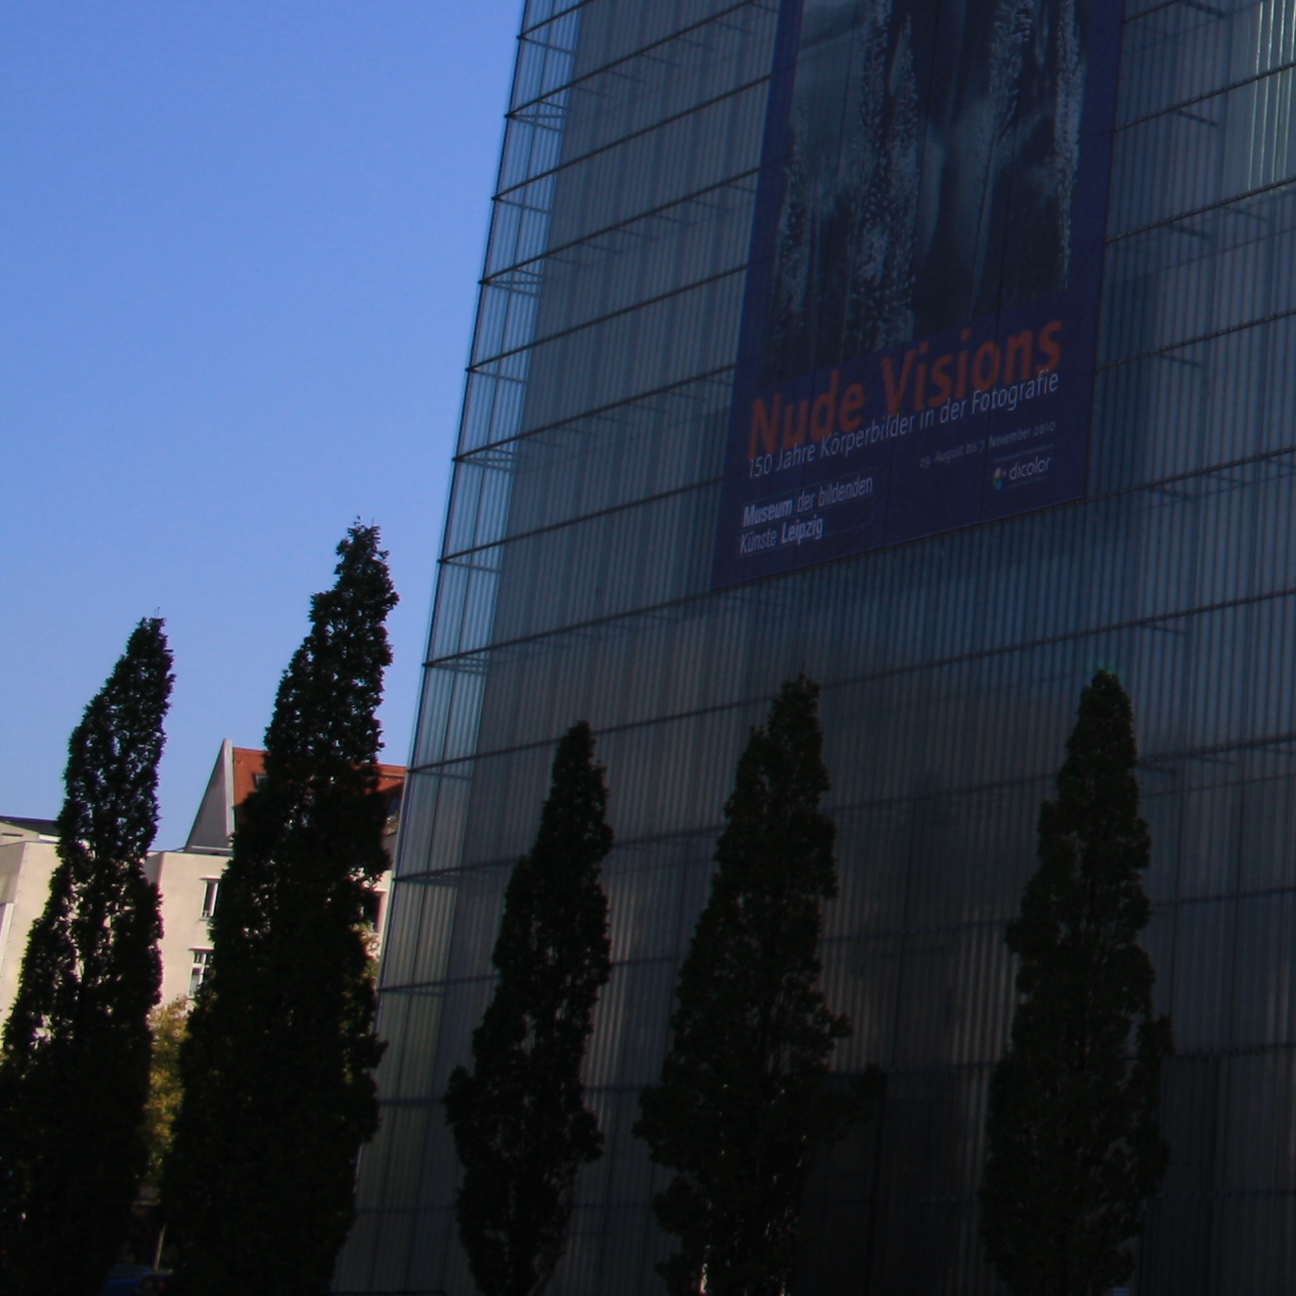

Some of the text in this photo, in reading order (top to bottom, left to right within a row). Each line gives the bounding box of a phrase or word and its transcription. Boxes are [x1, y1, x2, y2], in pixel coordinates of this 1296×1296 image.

[748, 320, 1062, 461] Nude Visions
[749, 368, 1058, 478] 150 Jahre Körperbilder in der Fotografie
[1034, 421, 1056, 436] 2010
[1009, 455, 1051, 480] dicolor
[743, 475, 873, 527] Museum der bildenden
[740, 514, 824, 554] Künste Leipzig
